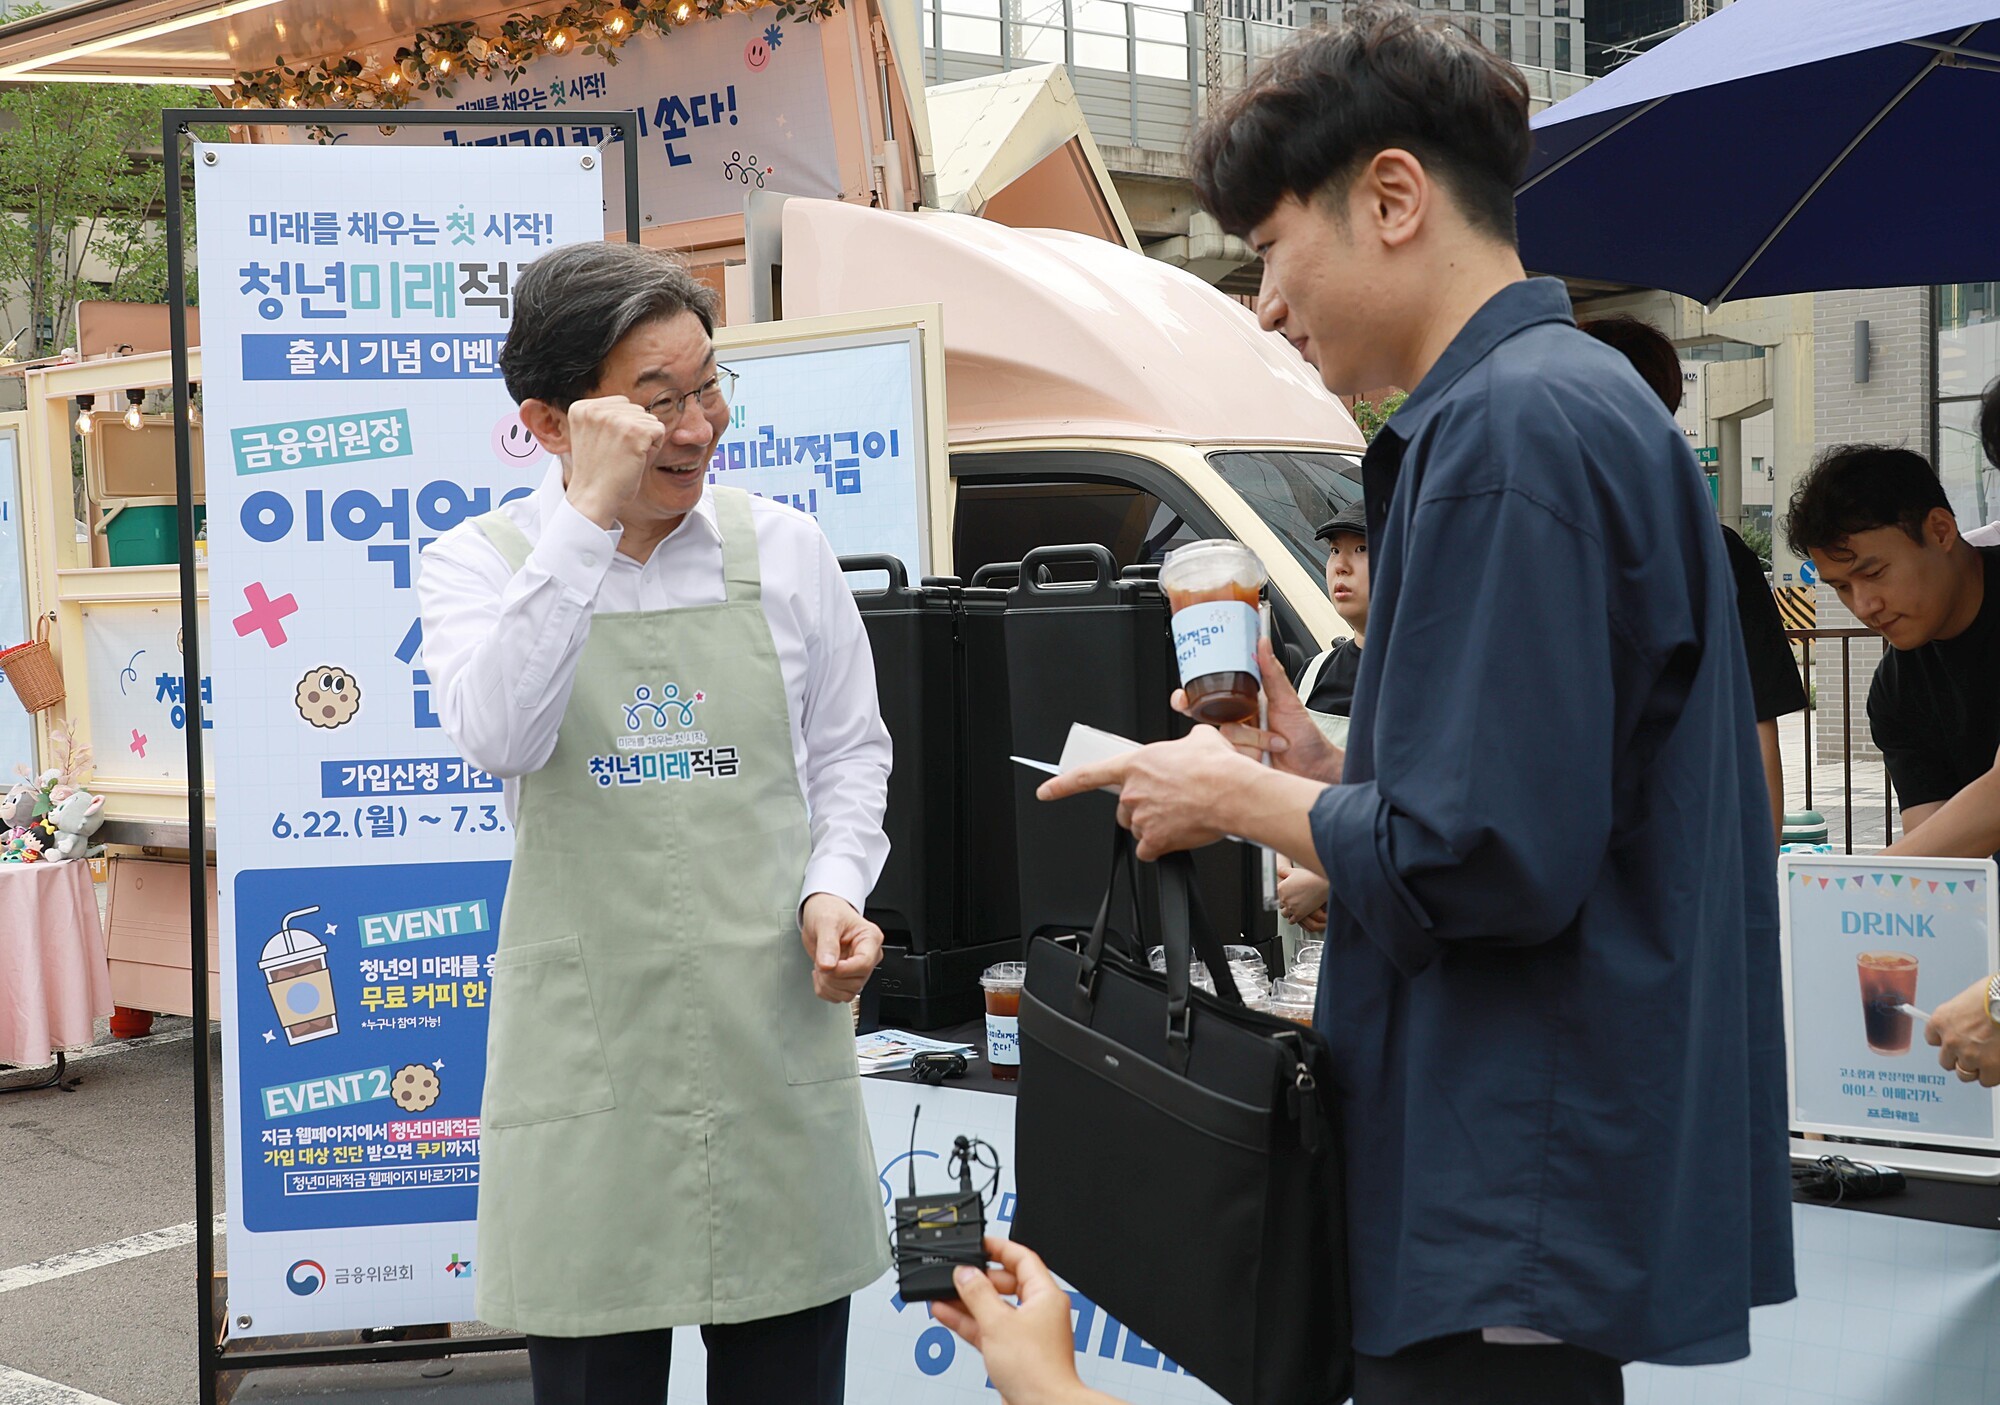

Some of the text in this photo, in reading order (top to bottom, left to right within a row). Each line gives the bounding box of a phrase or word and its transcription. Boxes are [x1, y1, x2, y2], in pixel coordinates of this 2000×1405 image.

[550, 75, 565, 107] 첫
[569, 71, 606, 100] 시작!
[654, 84, 739, 167] 쏜다!
[248, 204, 553, 246] 미래를 채우는 첫 시작!
[239, 260, 524, 320] 청년미래적
[286, 338, 504, 375] 출시 기념 이벤
[240, 415, 402, 469] 금융위원장
[618, 736, 645, 747] 미래를
[648, 734, 674, 746] 채우는
[675, 733, 684, 743] 첫
[341, 762, 440, 792] 가입신청
[589, 747, 739, 786] 청년미래적금
[271, 804, 408, 839] 6.22.(월)
[363, 903, 482, 946] EVENT 1
[1841, 910, 1937, 938] DRINK
[359, 957, 418, 983] 청년의
[422, 956, 480, 979] 미래를
[360, 980, 488, 1012] 무료 커피 한
[397, 1017, 417, 1029] 참여
[418, 1015, 441, 1028] 가능!
[992, 1042, 1011, 1056] 쏜다!
[265, 1069, 390, 1117] EVENT 2
[1842, 1083, 1944, 1103] 아이스 아메리카노
[261, 1118, 481, 1147] 지금 웹페이지에서 청년미래적금
[264, 1139, 481, 1167] 가입 대상 진단 받으면 쿠키까지!
[292, 1167, 468, 1192] 청년미래적금 웹페이지 바로가기
[333, 1264, 414, 1285] 금융위원회
